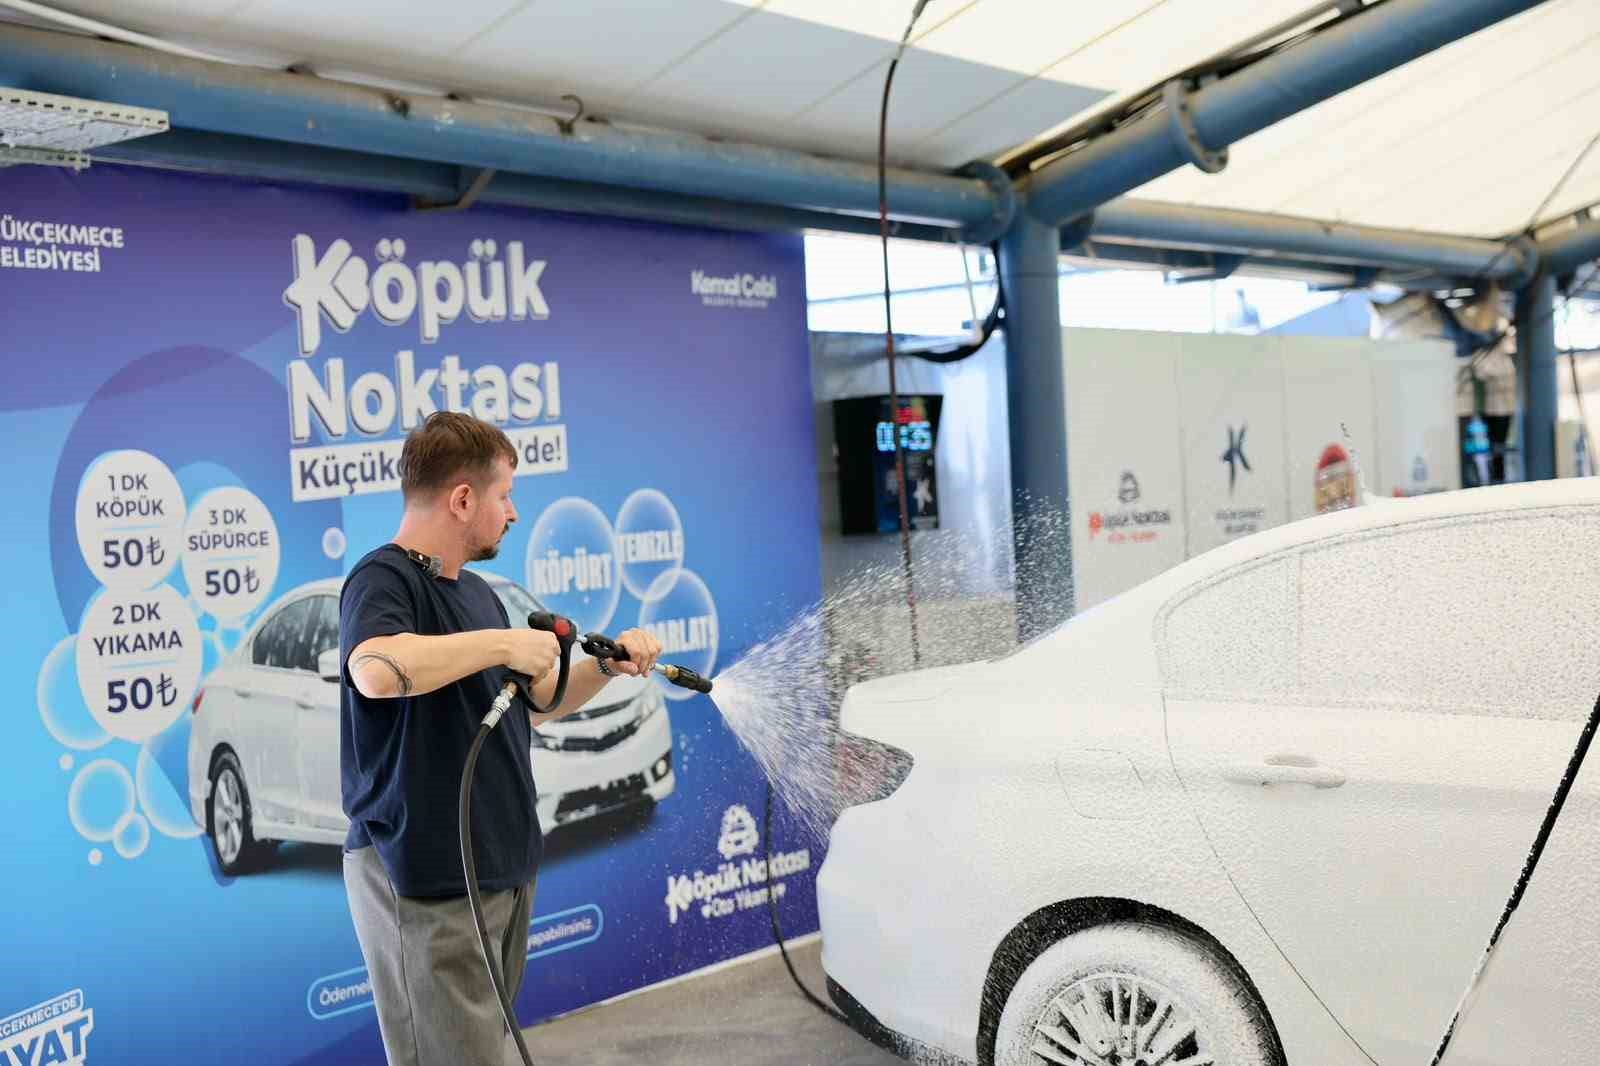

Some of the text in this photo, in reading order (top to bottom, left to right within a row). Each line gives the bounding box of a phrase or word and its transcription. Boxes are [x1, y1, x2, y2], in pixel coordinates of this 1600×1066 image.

[283, 233, 550, 357] Köpük
[287, 349, 562, 445] Noktası
[108, 473, 149, 491] 1 DK
[96, 495, 165, 518] KÖPÜK
[208, 507, 247, 525] 3 DK
[187, 529, 271, 551] SÜPÜRGE
[111, 602, 162, 626] 2 DK
[93, 630, 184, 657] YIKAMA
